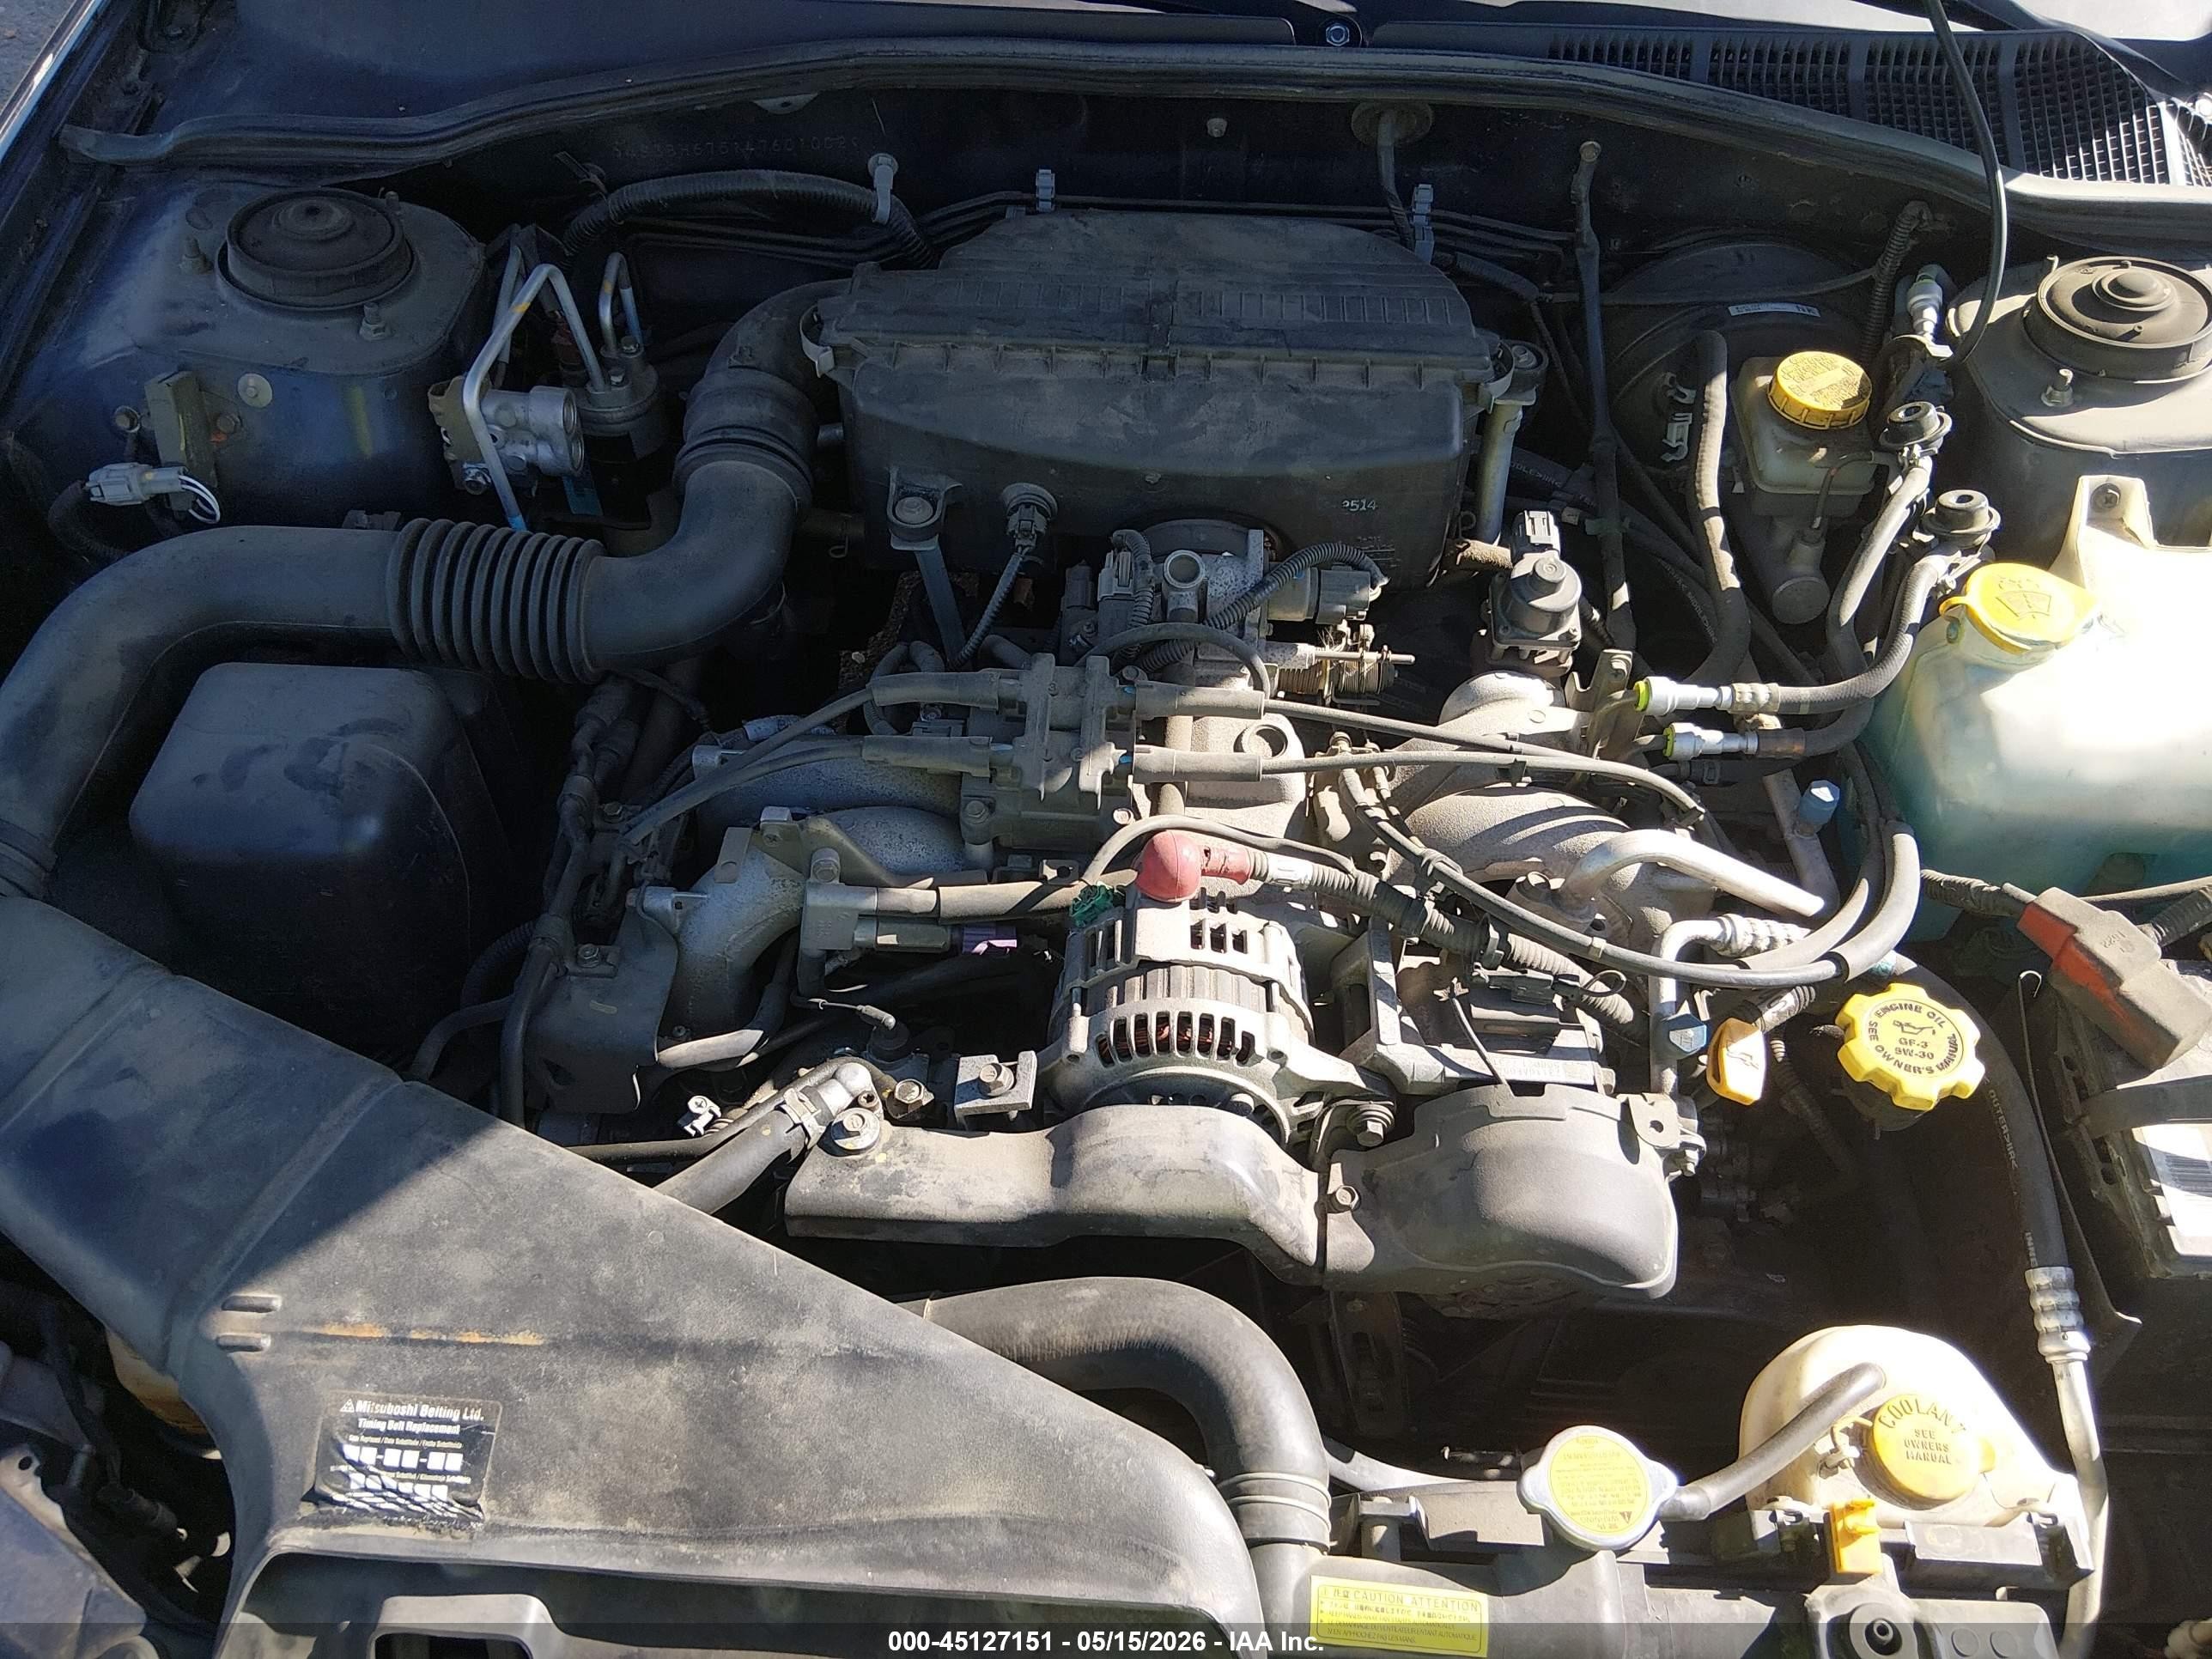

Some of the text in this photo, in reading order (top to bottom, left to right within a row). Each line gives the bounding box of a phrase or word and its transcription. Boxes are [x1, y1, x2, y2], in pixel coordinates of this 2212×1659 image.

[1875, 1003, 1946, 1030] ENGINE OIL
[1868, 1020, 1959, 1074] SEE OWNER'S MANUAL
[1899, 1036, 1929, 1049] GF-3
[355, 1401, 485, 1422] Mitsuboshi Belting Ltd.
[357, 1418, 461, 1435] Timing Belt Replacement
[1914, 1429, 1936, 1440] SEE
[1905, 1450, 1952, 1465] MANUAL
[1353, 1589, 1404, 1604] CAUTION
[1411, 1596, 1479, 1613] ATTENTION
